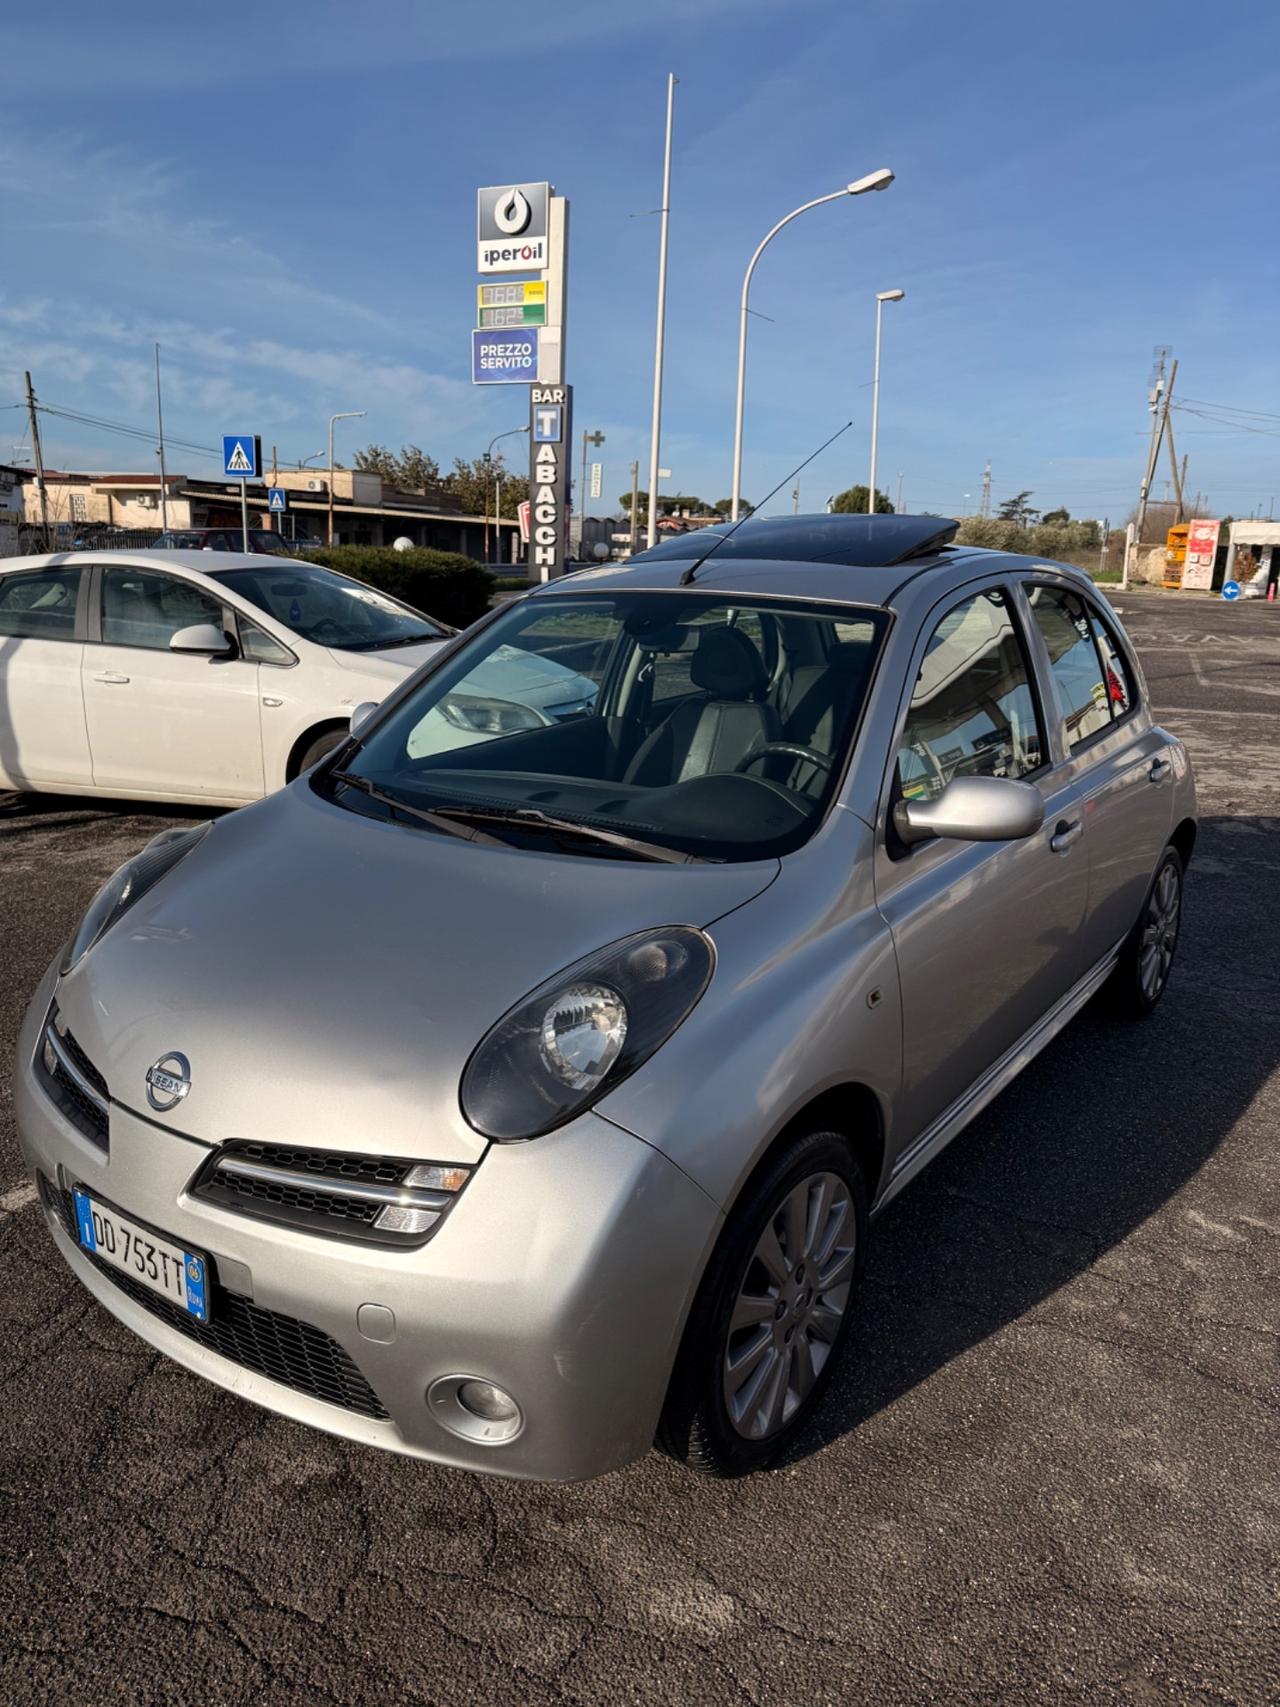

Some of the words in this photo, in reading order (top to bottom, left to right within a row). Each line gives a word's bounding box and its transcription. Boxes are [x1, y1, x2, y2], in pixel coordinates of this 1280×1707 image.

[480, 343, 532, 357] PREZZO
[480, 356, 532, 369] SERVITO
[532, 389, 565, 403] BAR
[535, 410, 558, 583] TABACCHI
[149, 1069, 183, 1095] SSAN
